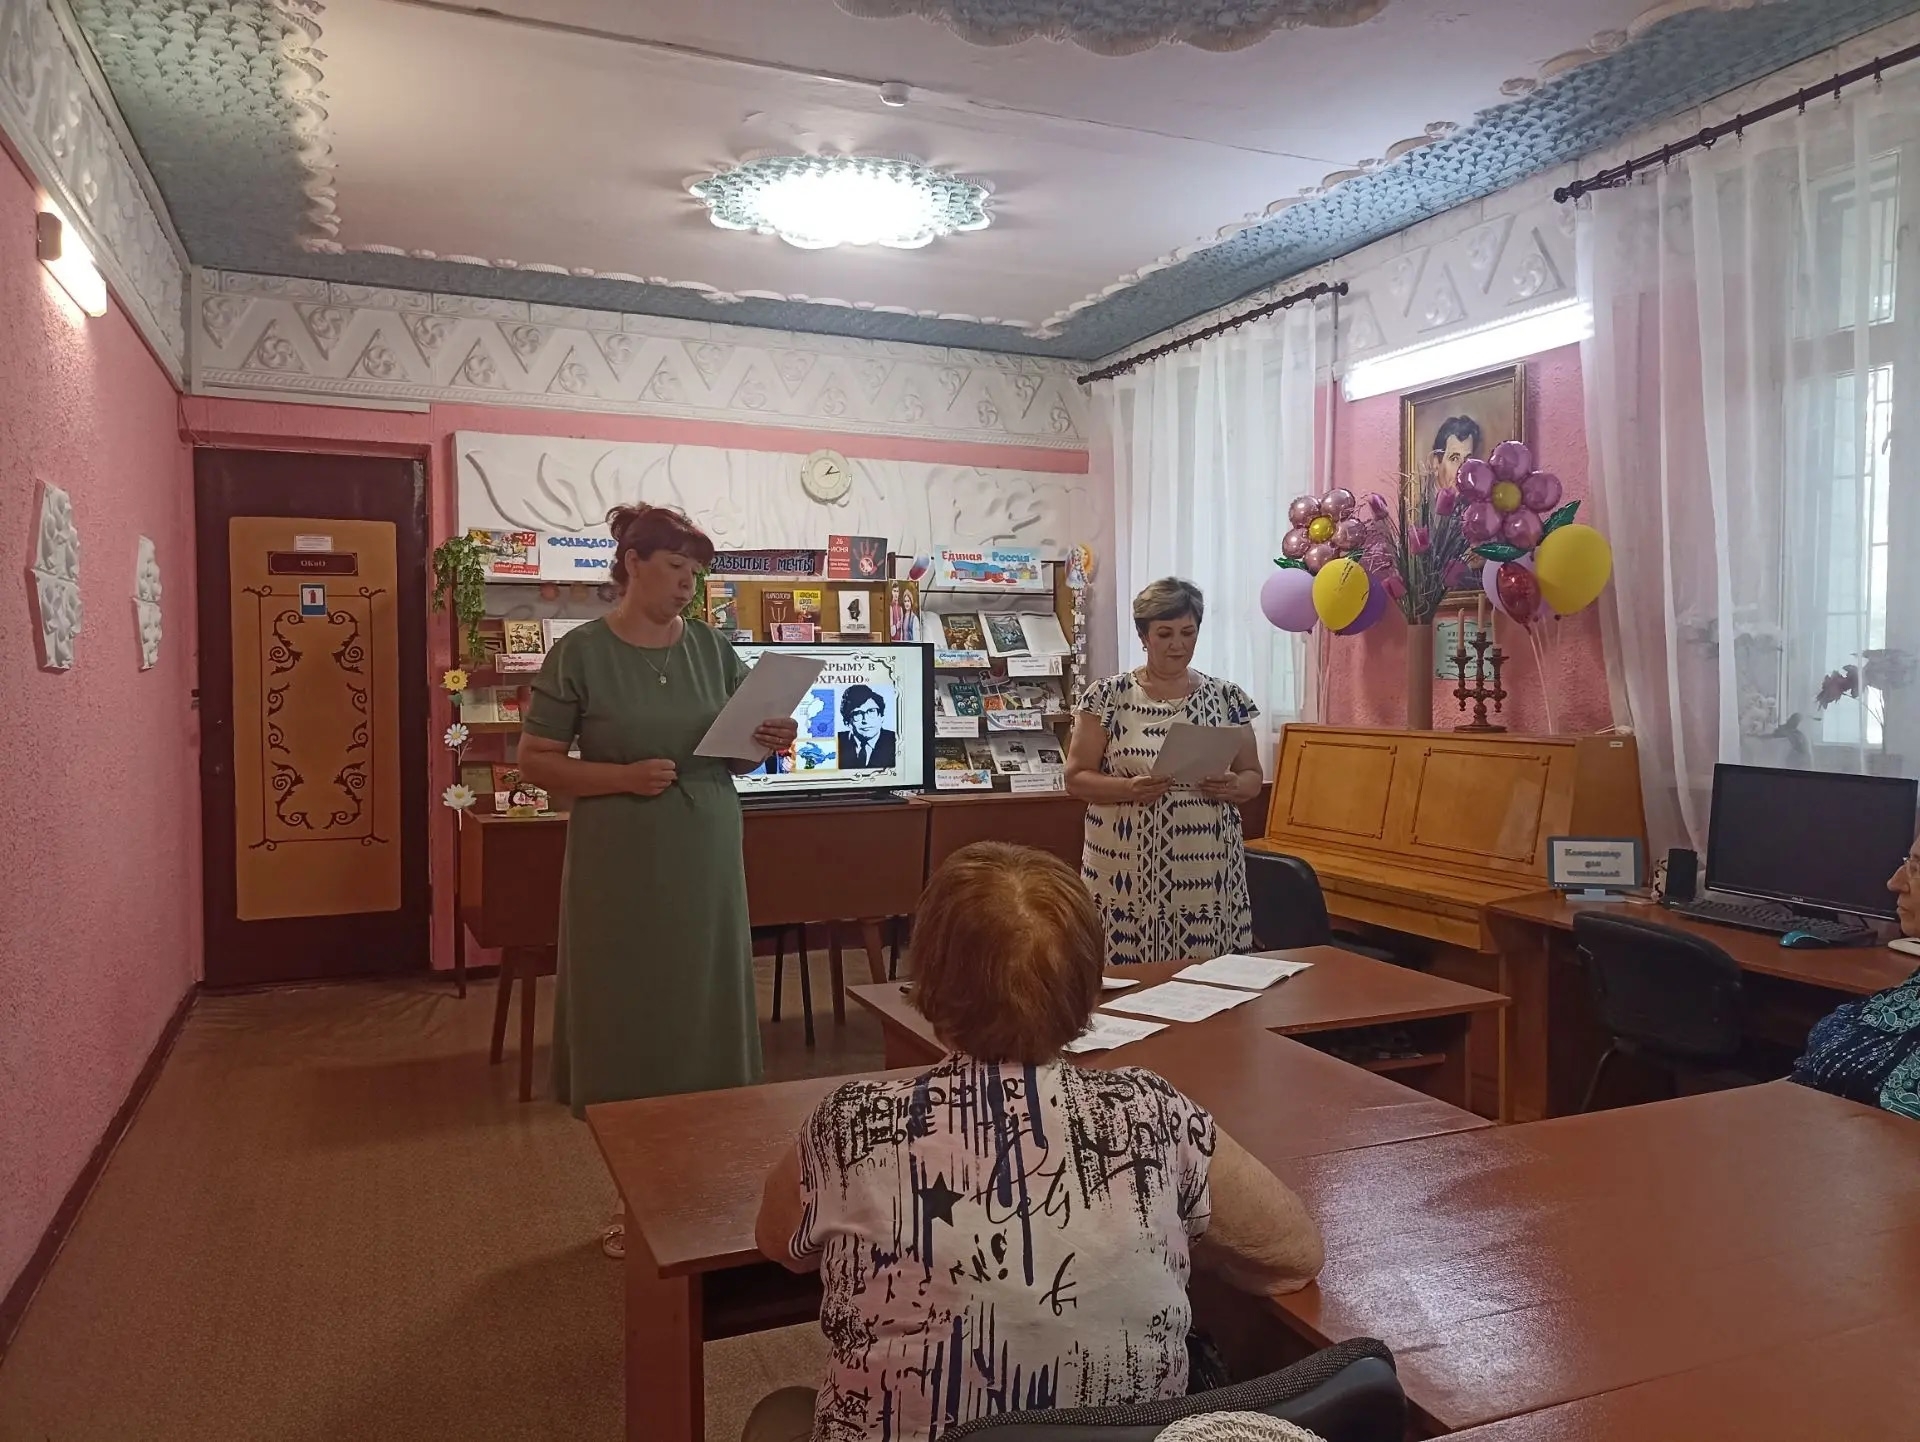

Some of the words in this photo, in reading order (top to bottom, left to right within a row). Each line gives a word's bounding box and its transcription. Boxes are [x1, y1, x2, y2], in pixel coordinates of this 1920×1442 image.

[941, 551, 983, 562] Единая
[992, 552, 1030, 563] Россия
[573, 558, 615, 568] НАРО
[711, 556, 770, 571] РАЗБИТЫЕ
[776, 558, 815, 573] МЕЧТЫ
[868, 662, 876, 672] В
